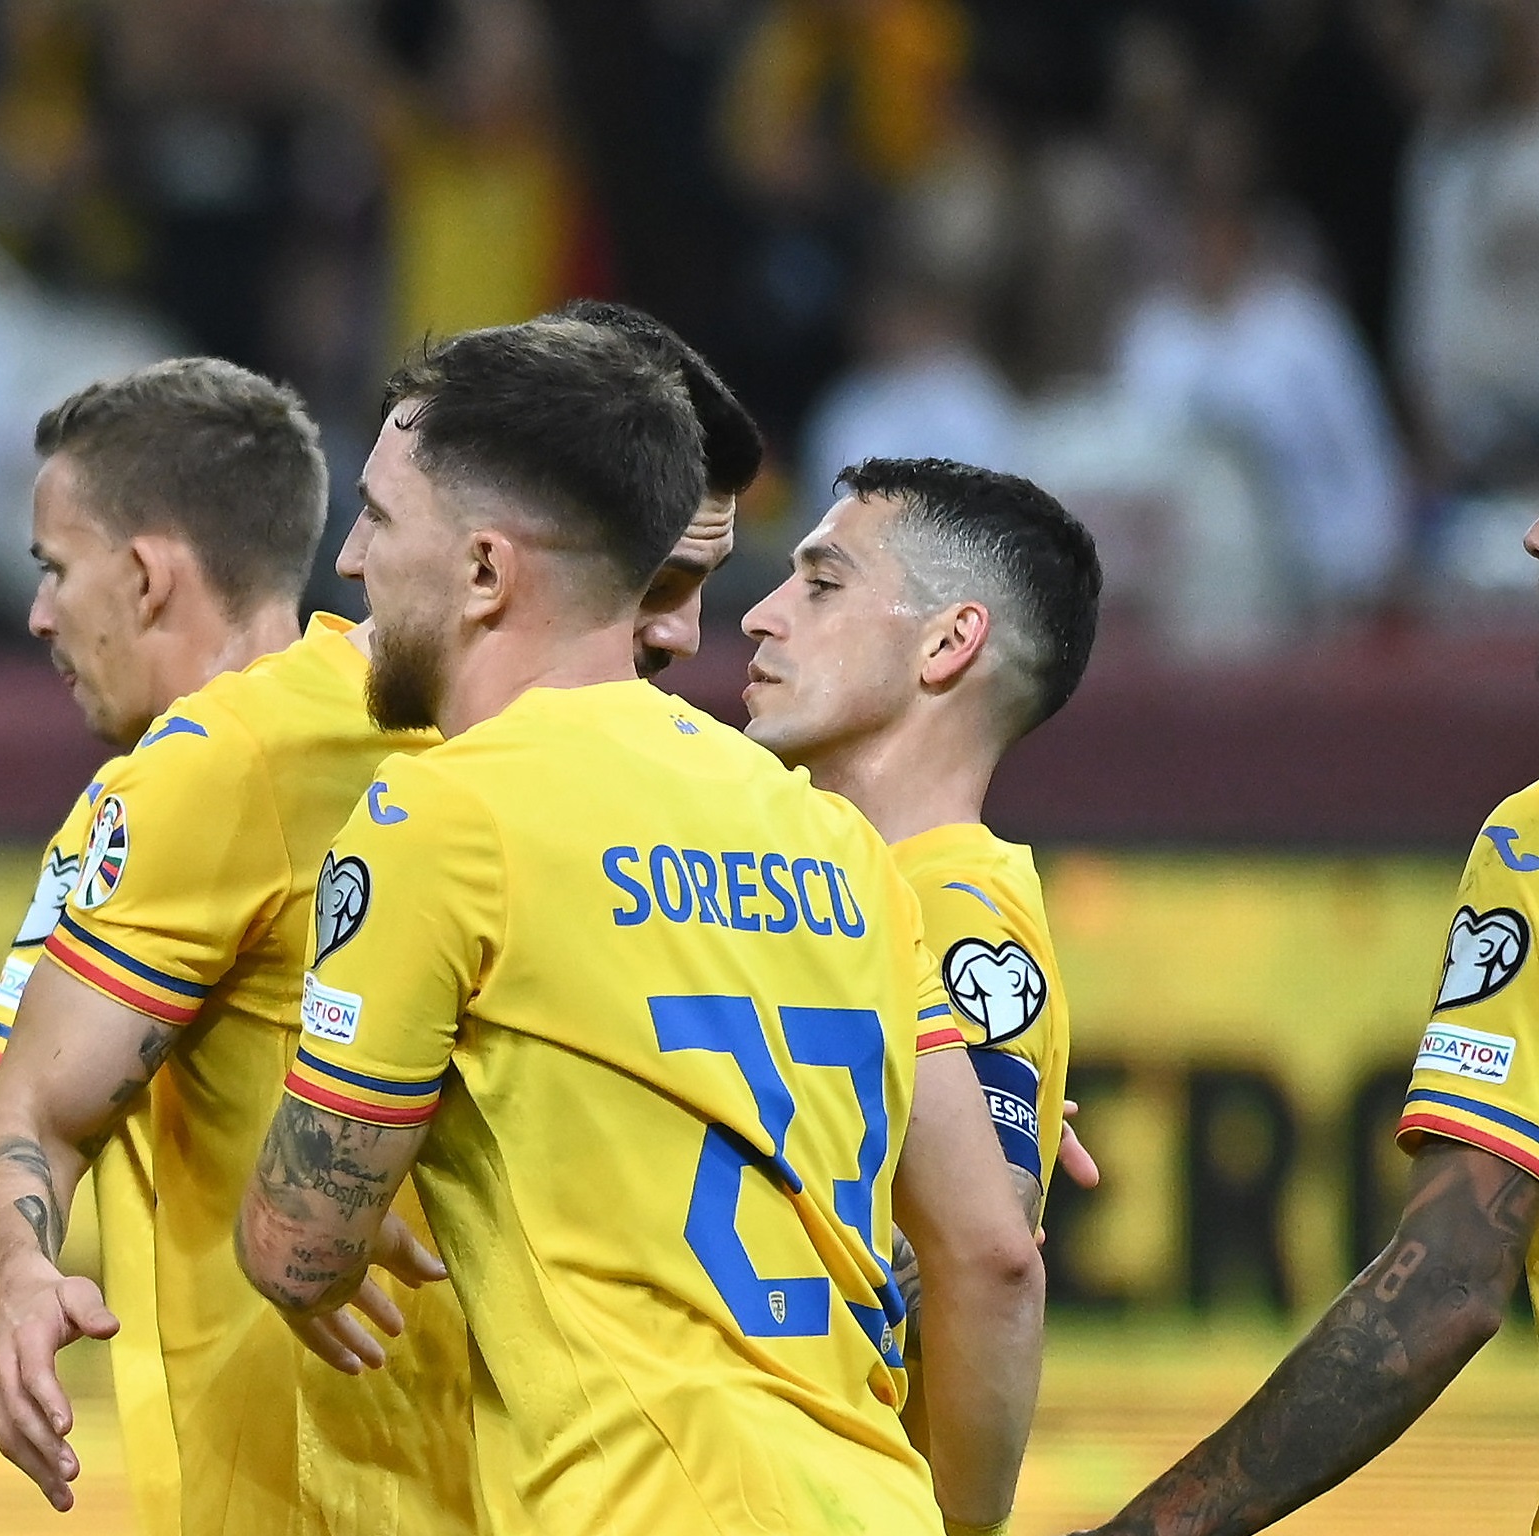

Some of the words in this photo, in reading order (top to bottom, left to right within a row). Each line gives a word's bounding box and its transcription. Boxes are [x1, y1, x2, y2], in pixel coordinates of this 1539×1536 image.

[602, 844, 867, 939] SORESCU
[1421, 1036, 1509, 1067] NDATION
[989, 1094, 1038, 1136] ESPE
[646, 994, 907, 1370] 23
